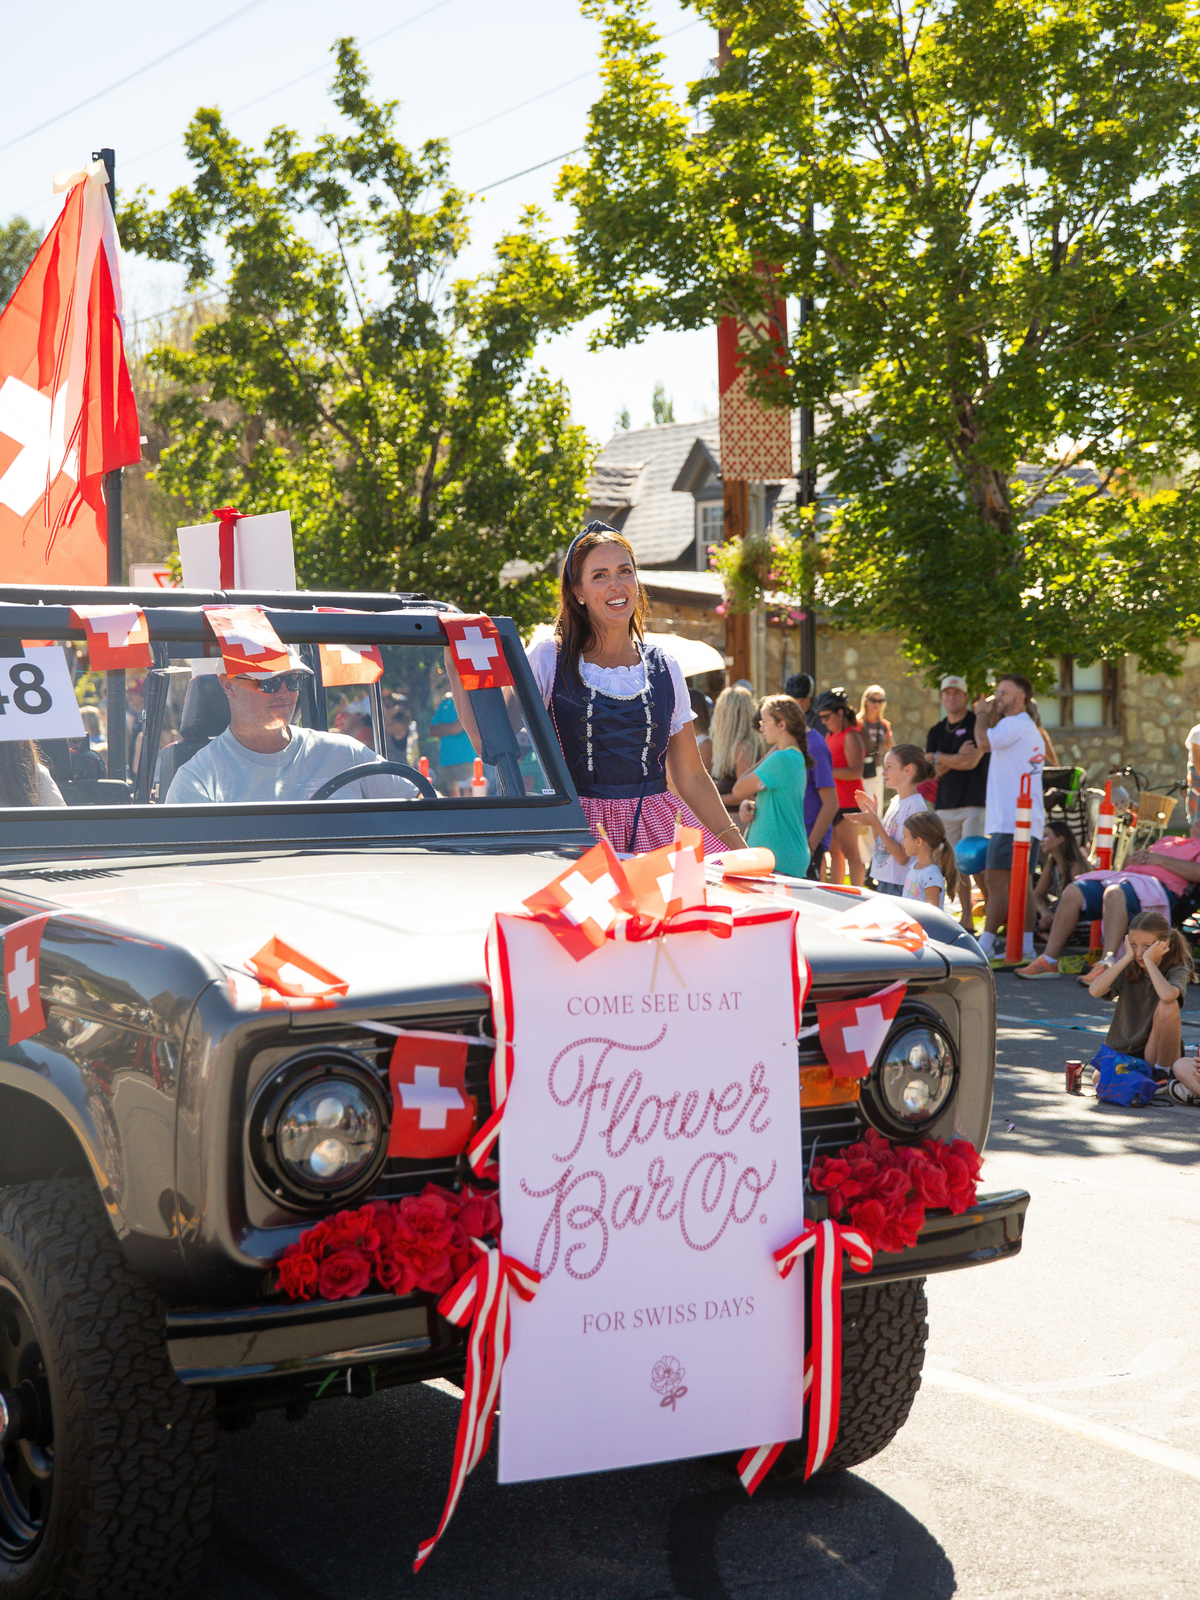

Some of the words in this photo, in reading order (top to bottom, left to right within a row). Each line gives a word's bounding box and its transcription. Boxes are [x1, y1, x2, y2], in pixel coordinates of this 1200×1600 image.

[567, 996, 634, 1016] COME
[641, 994, 680, 1013] SEE
[687, 992, 712, 1012] US
[718, 991, 742, 1010] AT
[548, 1023, 771, 1162] Flower
[520, 1156, 679, 1279] Bar
[680, 1152, 777, 1251] Co.
[582, 1311, 626, 1334] FOR
[633, 1303, 697, 1328] SWISS
[704, 1296, 755, 1320] DAYS
